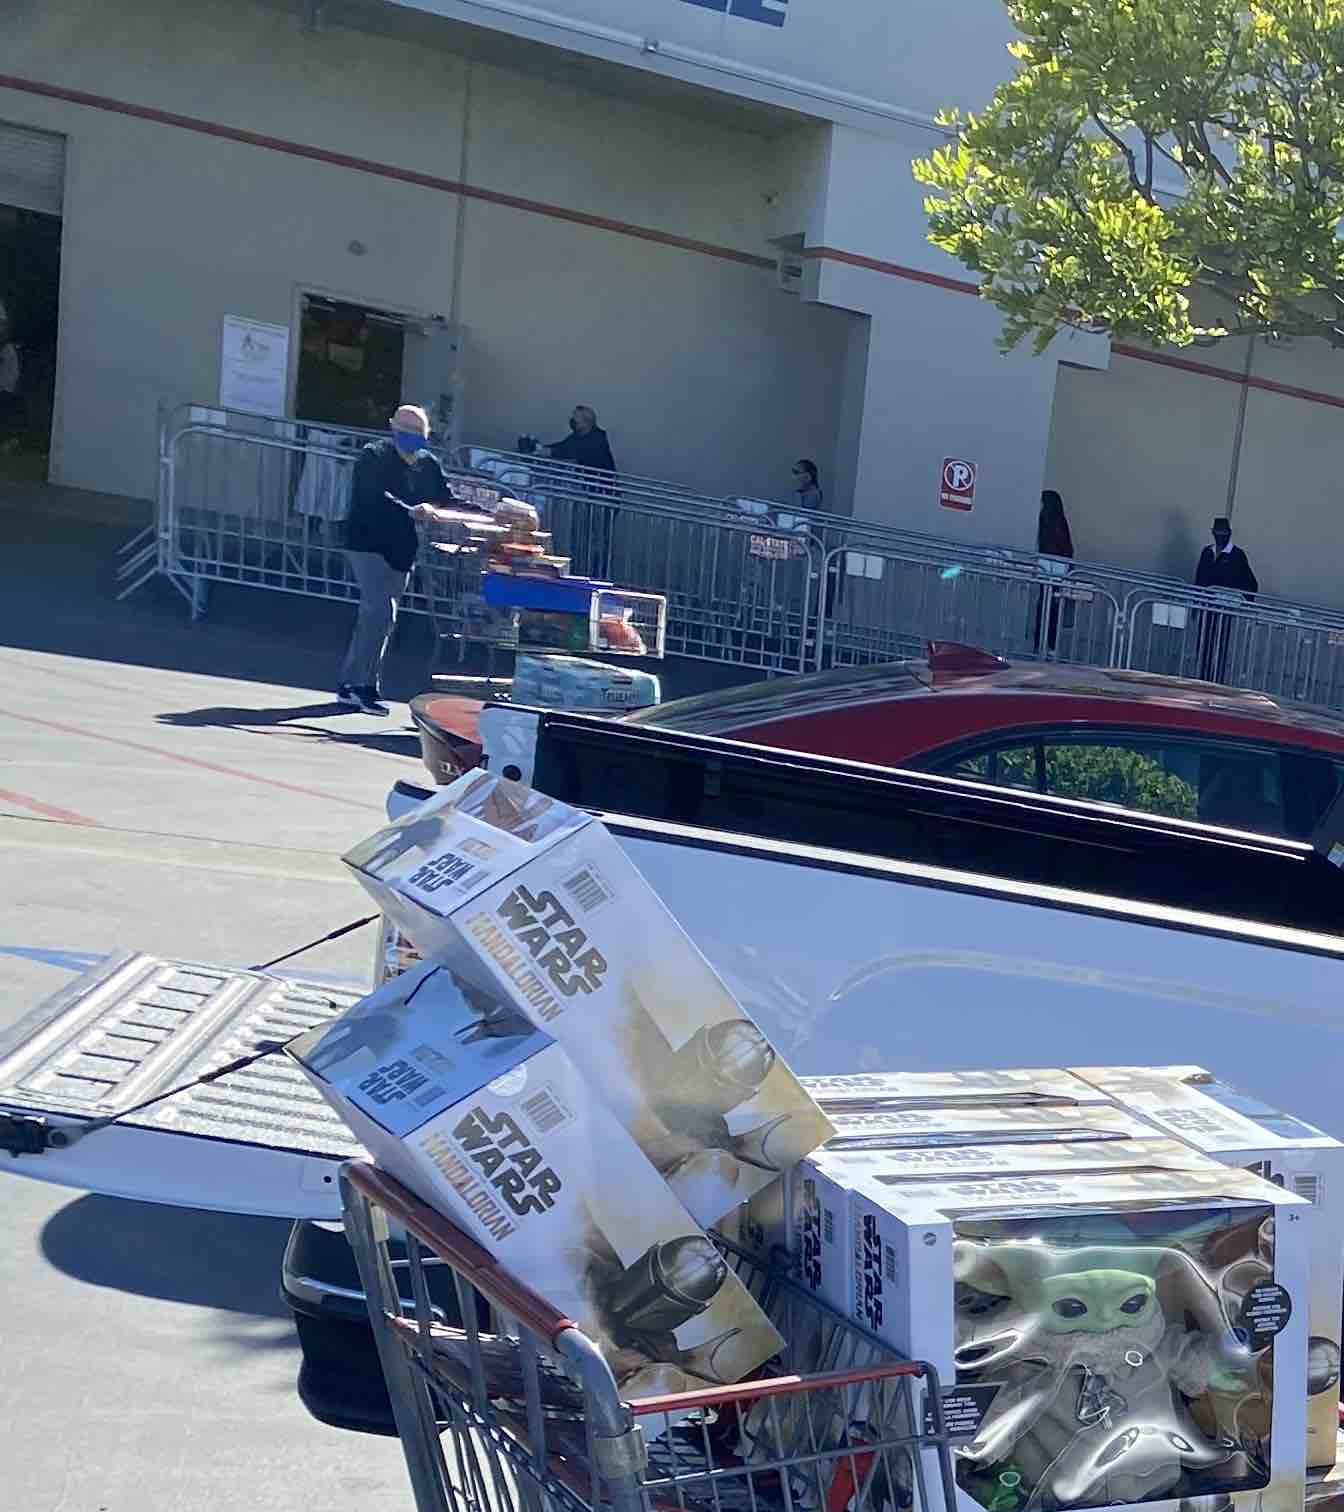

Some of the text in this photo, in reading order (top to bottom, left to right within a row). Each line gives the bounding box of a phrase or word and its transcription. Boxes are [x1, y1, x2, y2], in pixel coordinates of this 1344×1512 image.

[464, 912, 564, 1022] MANDALORIAN
[497, 891, 592, 996] WARS
[517, 884, 607, 989] STAR
[452, 1114, 545, 1216] WARS
[472, 1106, 562, 1209] STAR
